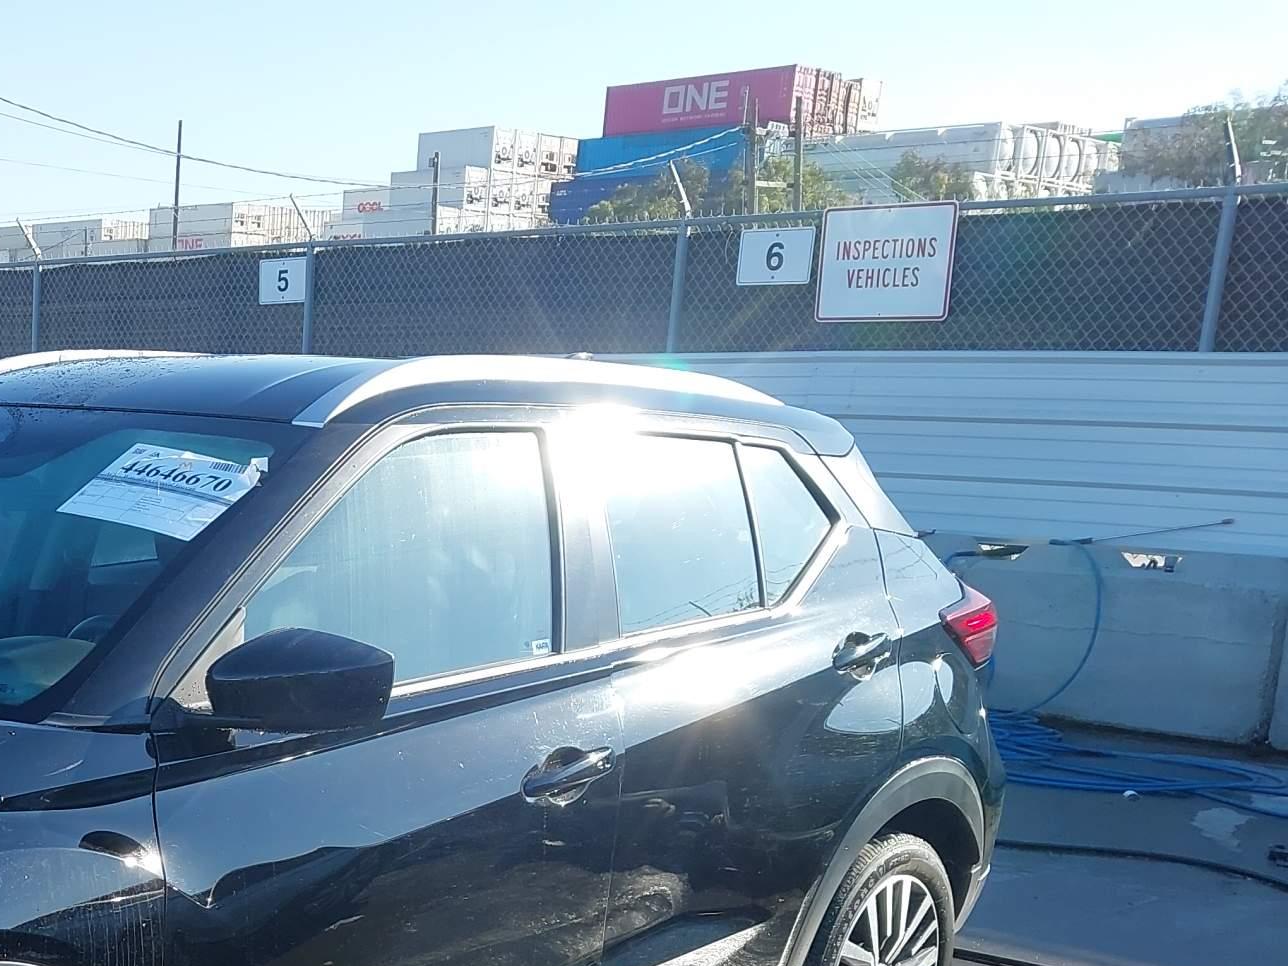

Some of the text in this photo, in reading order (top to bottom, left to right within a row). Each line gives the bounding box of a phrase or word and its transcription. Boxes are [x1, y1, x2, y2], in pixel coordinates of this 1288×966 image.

[662, 80, 730, 114] ONE
[766, 242, 785, 271] 6
[836, 237, 938, 261] INSPECTIONS
[277, 269, 289, 292] 5
[847, 267, 920, 289] VEHICLES
[120, 460, 233, 492] 44646670
